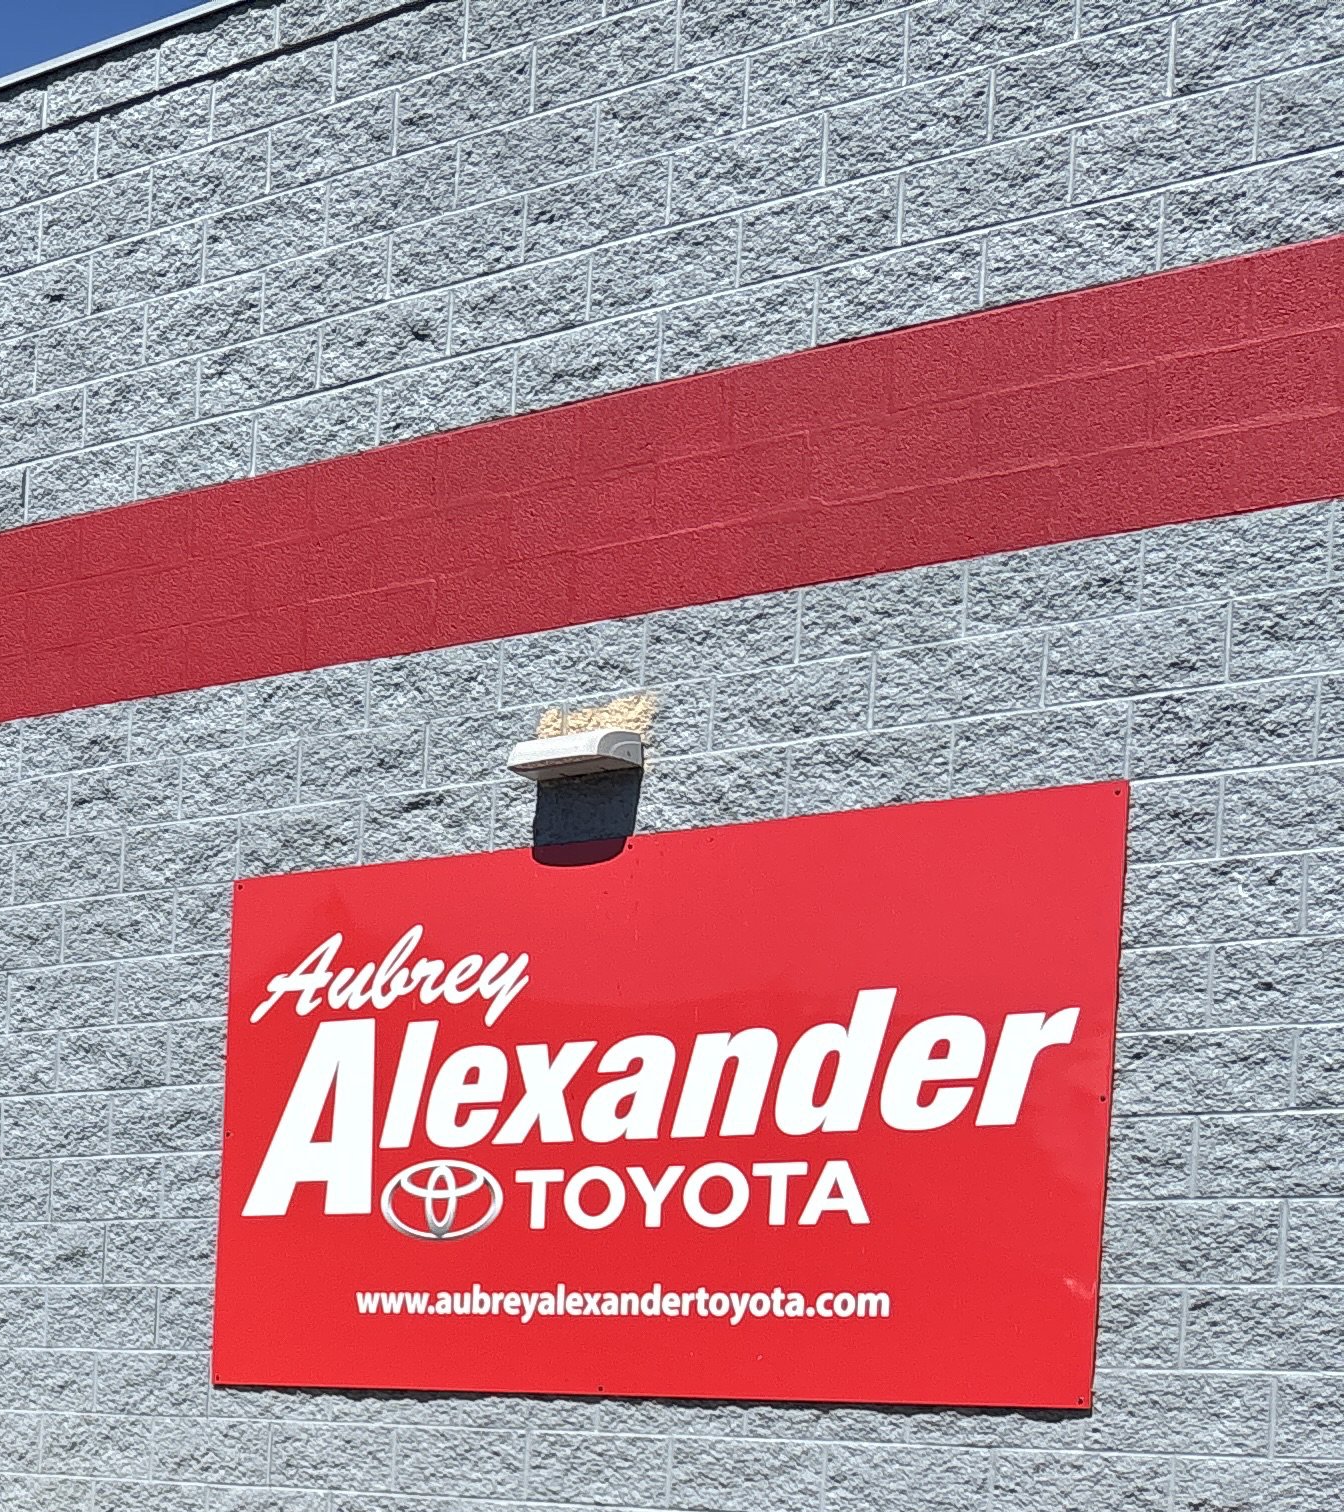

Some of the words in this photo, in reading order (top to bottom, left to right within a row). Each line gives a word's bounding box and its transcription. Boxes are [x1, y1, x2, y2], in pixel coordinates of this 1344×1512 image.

[250, 924, 529, 1028] Aubrey
[241, 987, 1081, 1217] Alexander
[515, 1160, 871, 1230] TOYOTA
[355, 1283, 890, 1326] www.aubreyalexandertoyota.com
